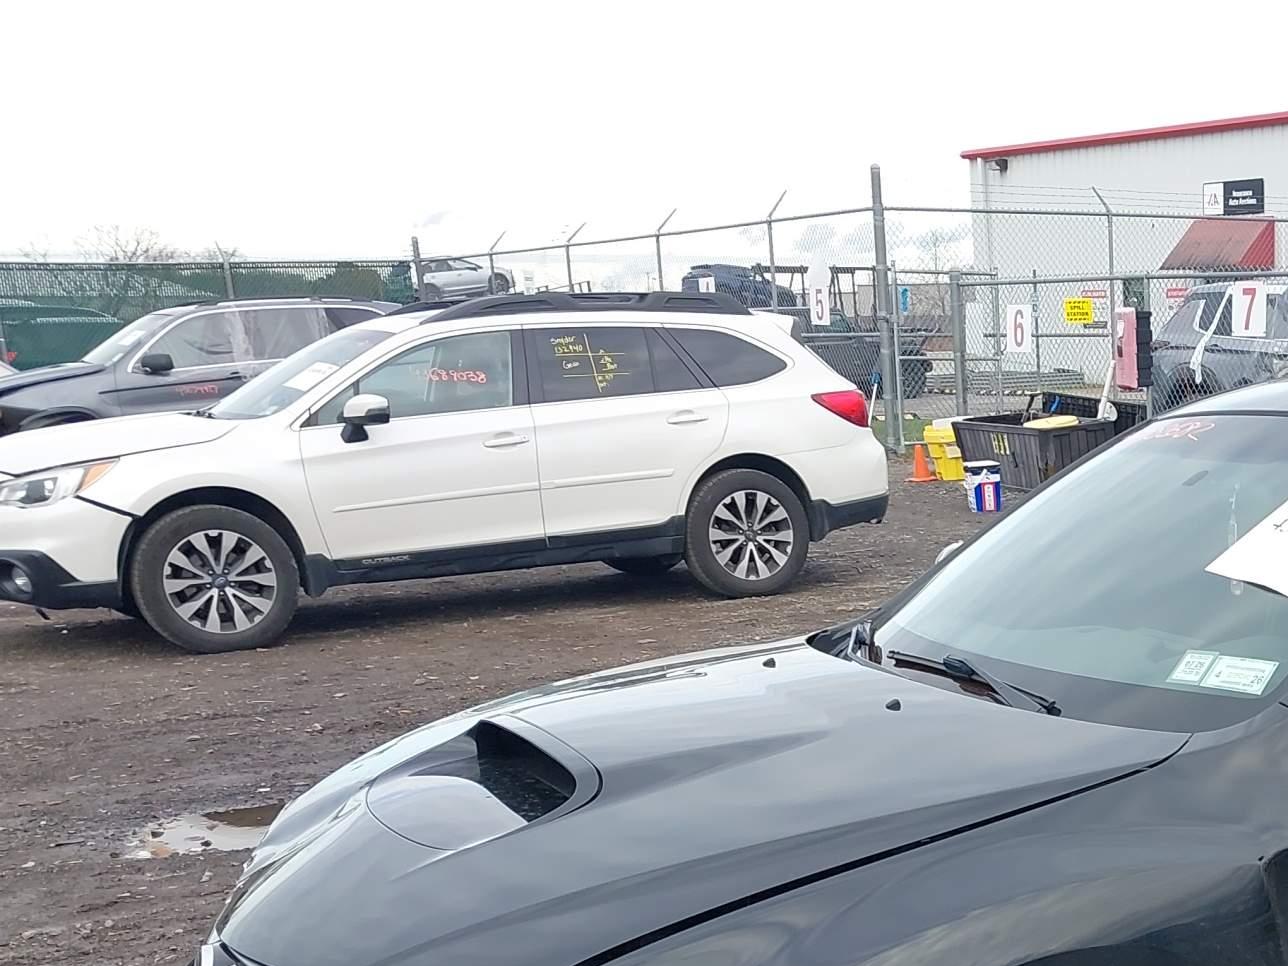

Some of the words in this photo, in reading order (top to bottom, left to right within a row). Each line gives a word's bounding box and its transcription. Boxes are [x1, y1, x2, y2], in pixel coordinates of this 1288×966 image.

[815, 288, 825, 321] 5
[1242, 287, 1257, 331] 7
[1013, 309, 1024, 347] 6
